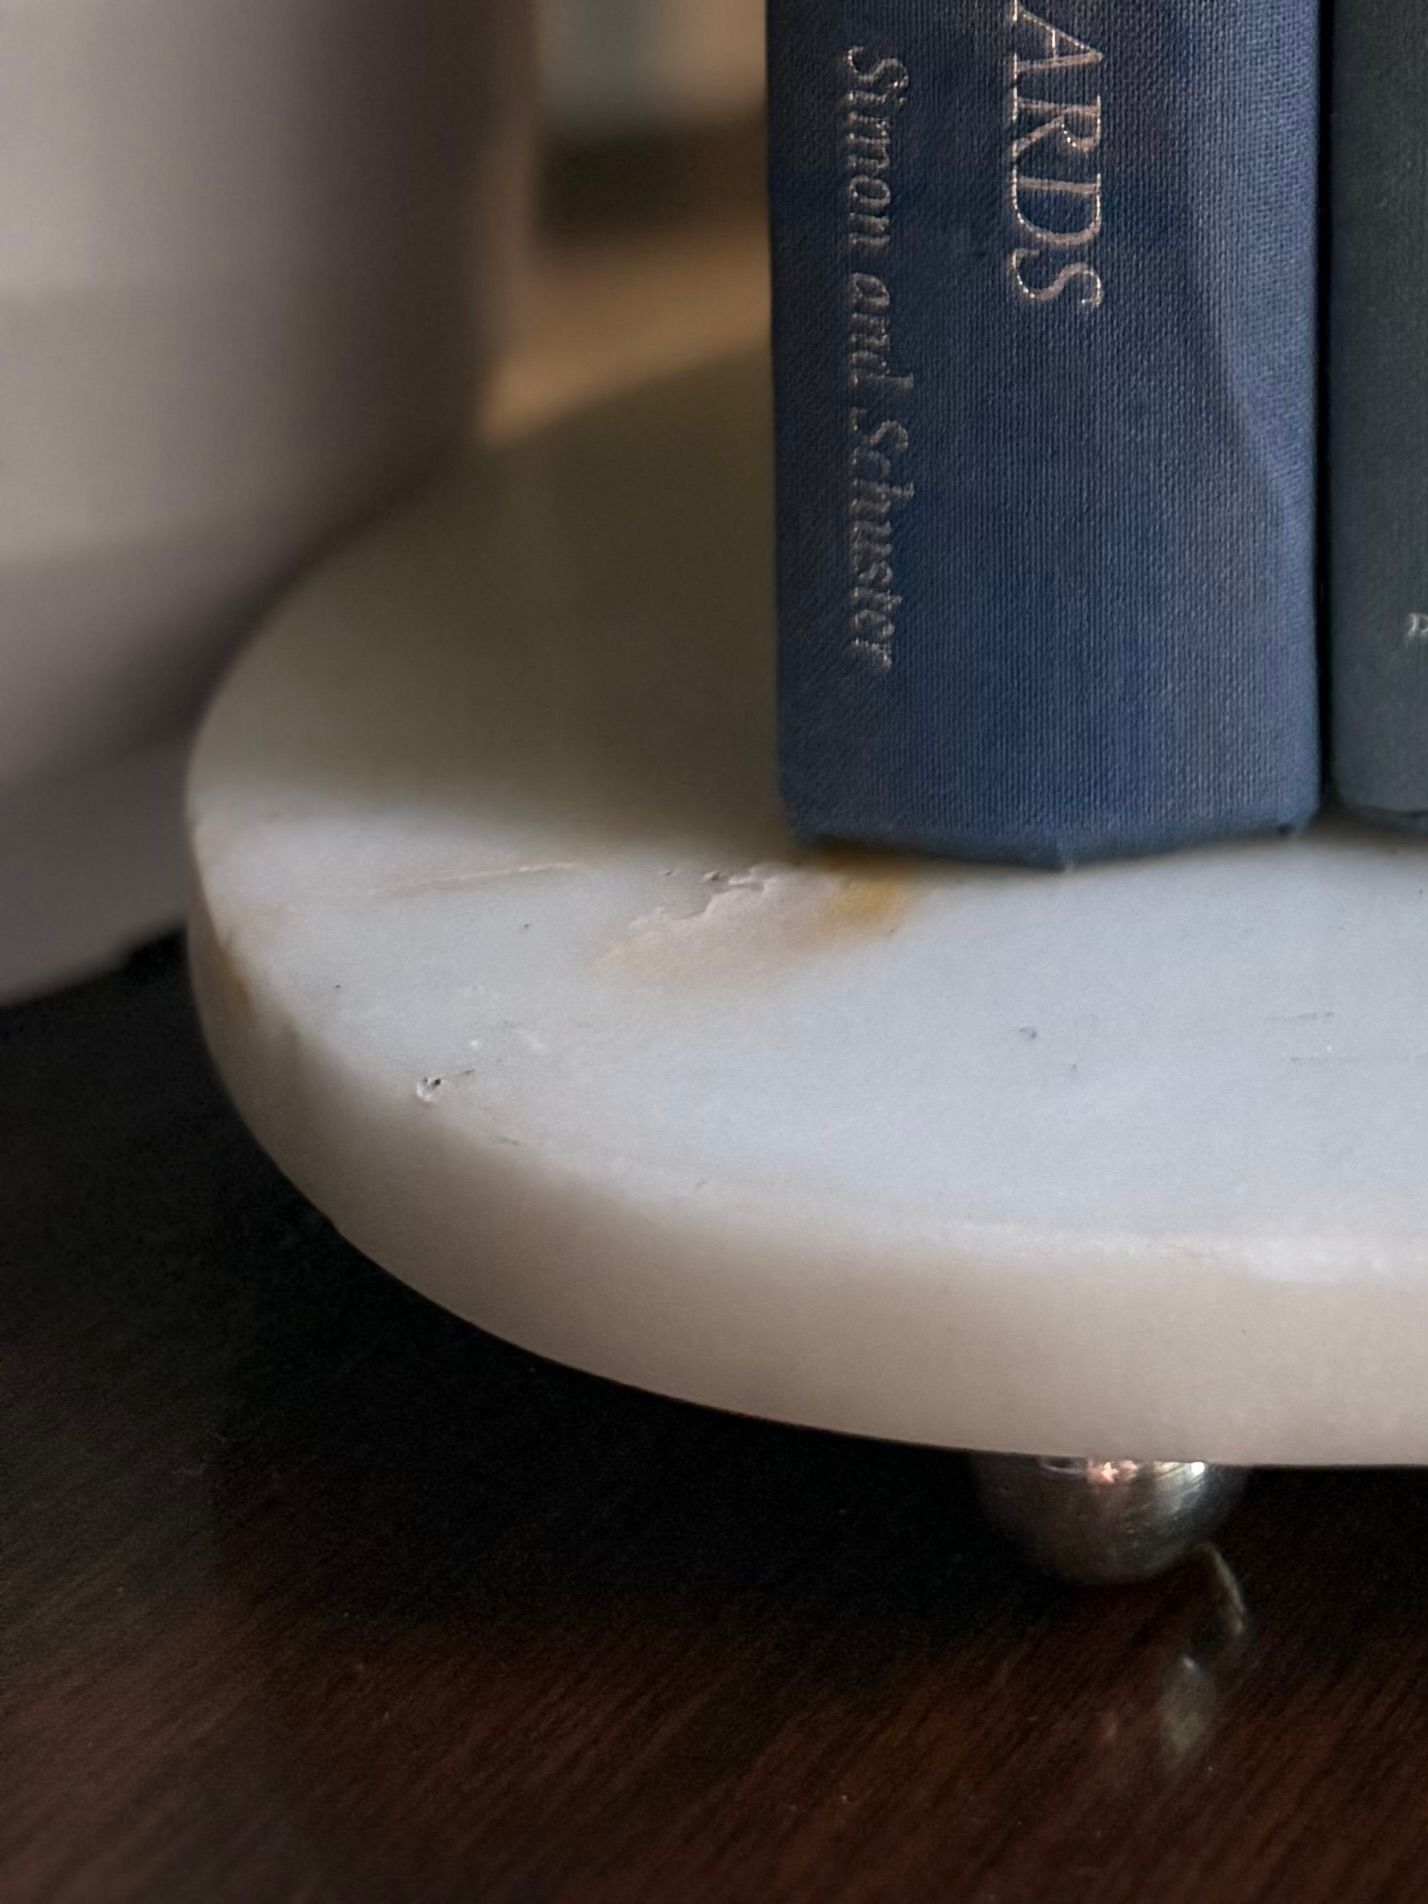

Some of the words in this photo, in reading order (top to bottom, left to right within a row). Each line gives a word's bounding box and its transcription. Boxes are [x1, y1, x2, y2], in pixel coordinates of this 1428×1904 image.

[846, 44, 910, 257] Simon
[846, 270, 914, 394] and
[846, 405, 915, 675] Schuster
